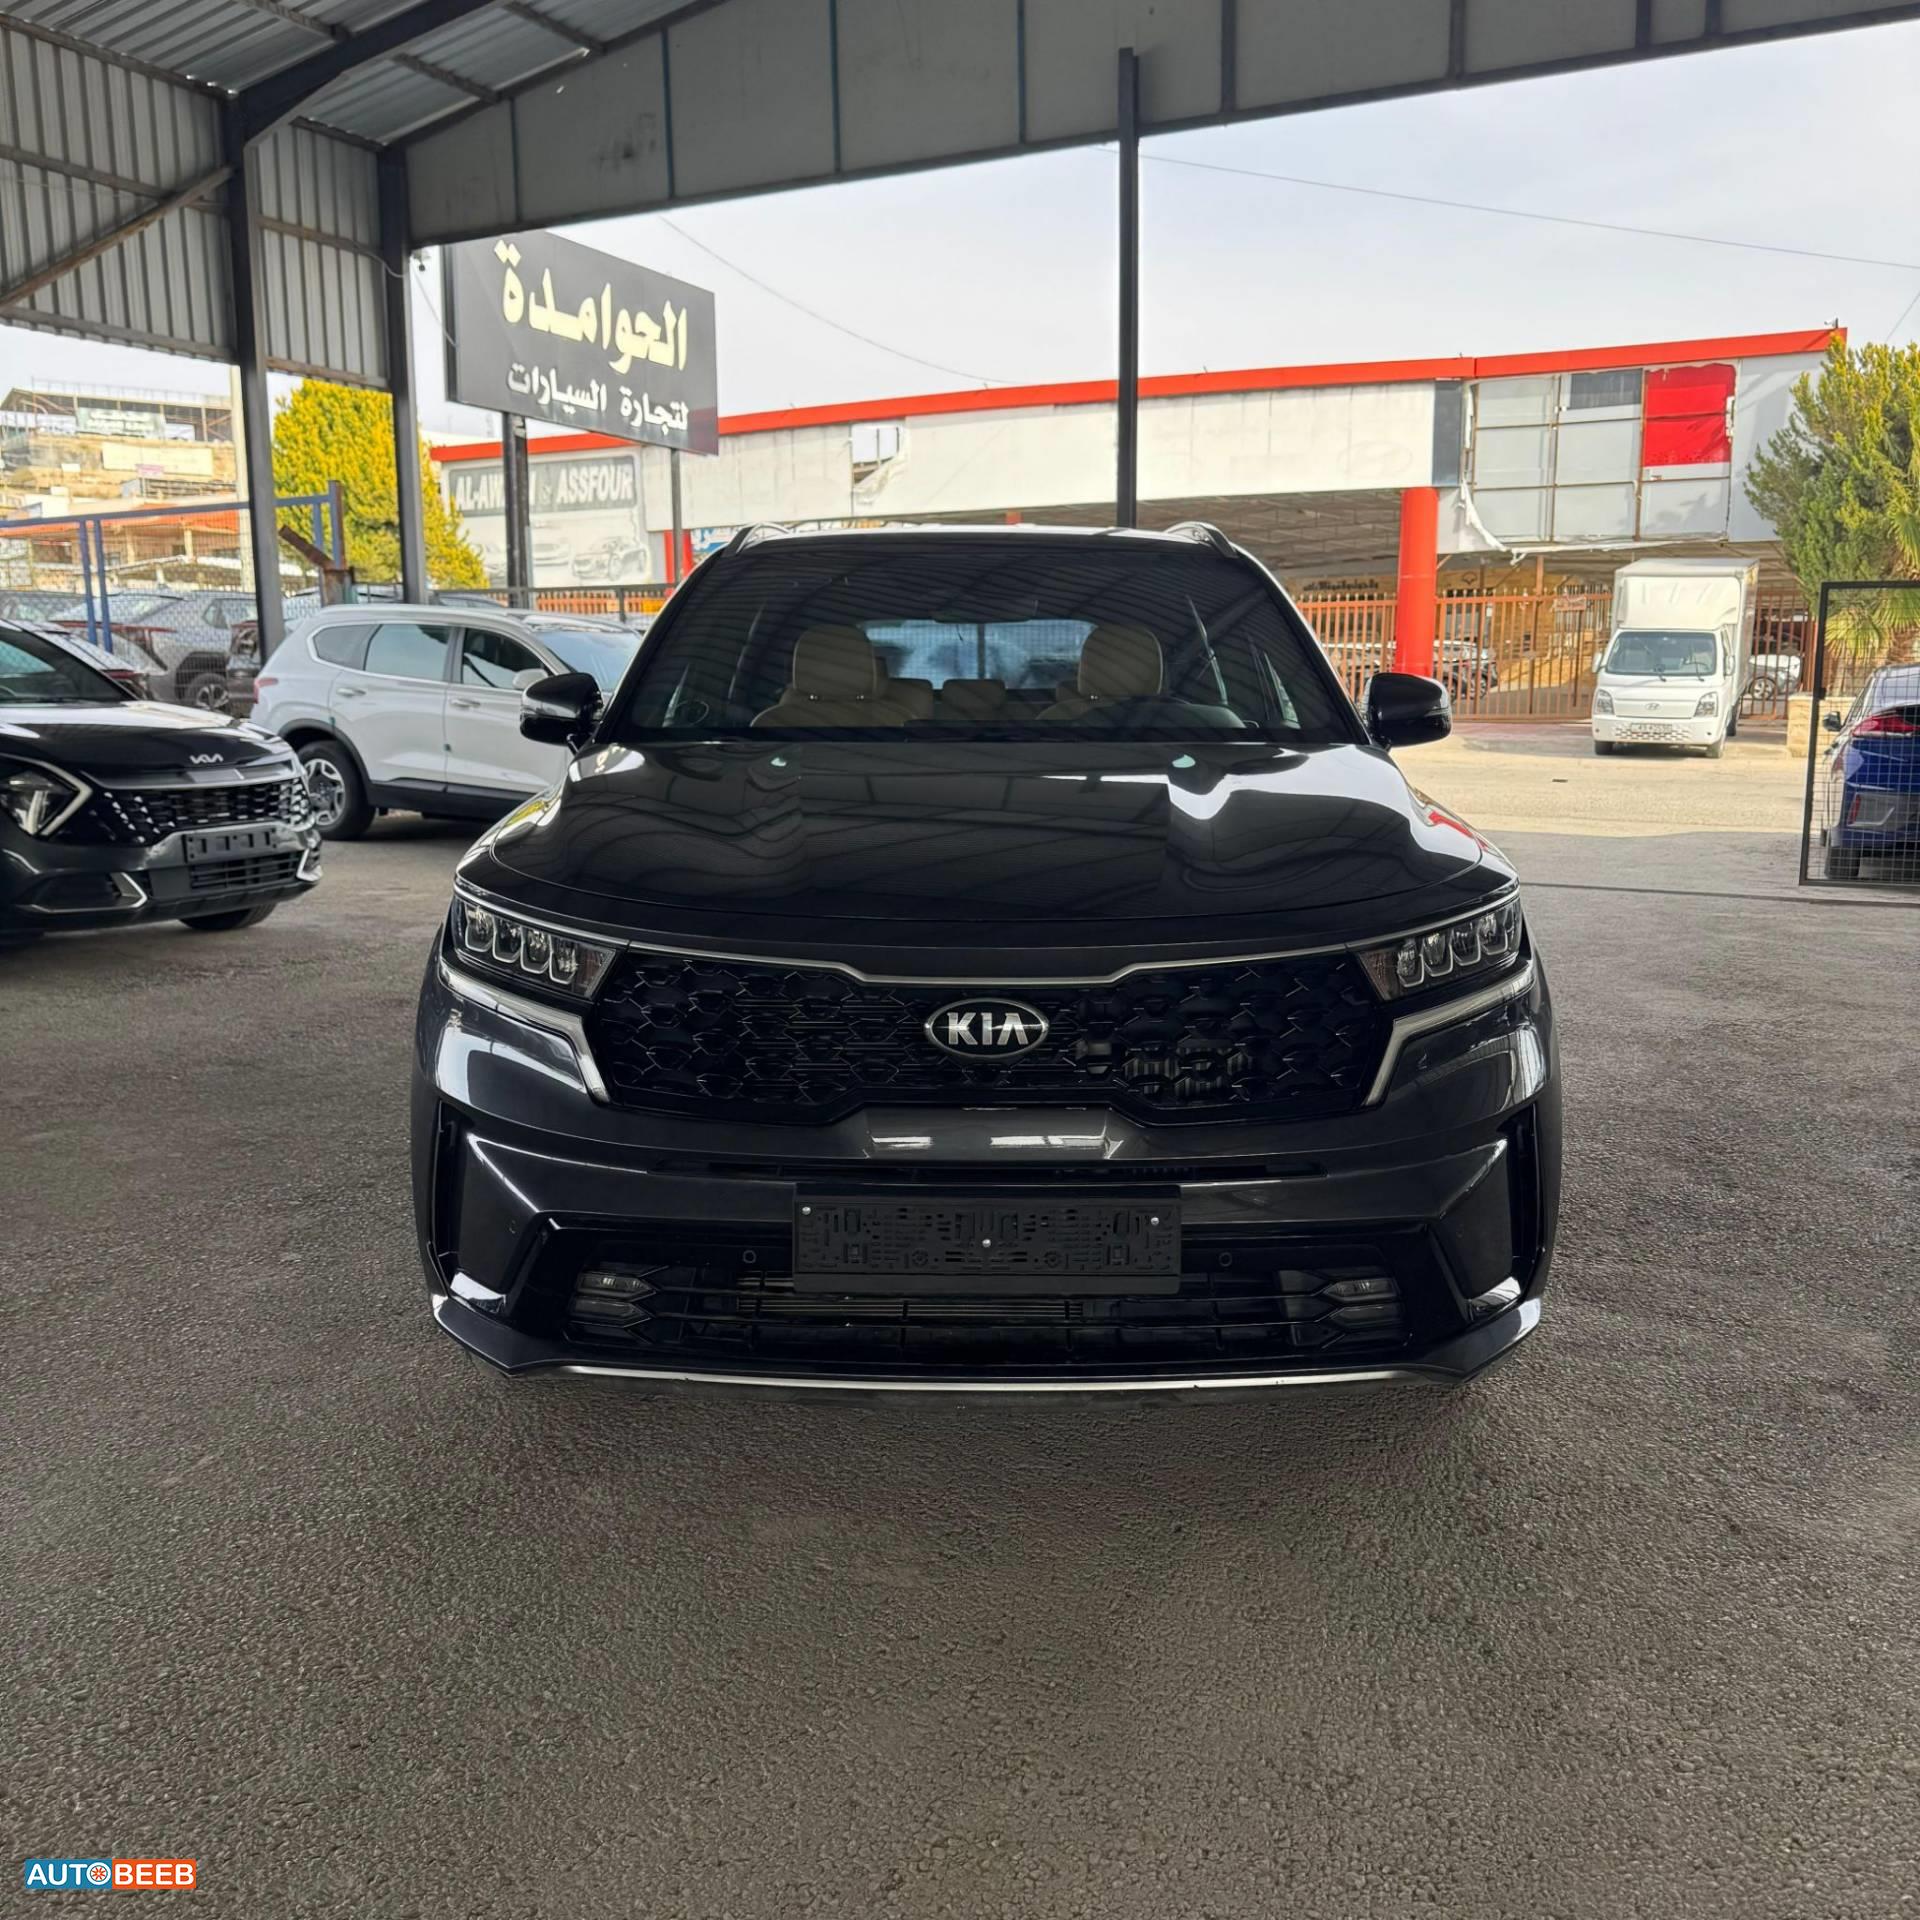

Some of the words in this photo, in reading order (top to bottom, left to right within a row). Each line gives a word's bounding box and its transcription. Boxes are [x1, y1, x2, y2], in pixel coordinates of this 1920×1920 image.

[508, 363, 607, 414] السيارات
[619, 386, 688, 435] لتجارة
[558, 463, 634, 504] ASSFOUR
[947, 1012, 1029, 1045] KIA
